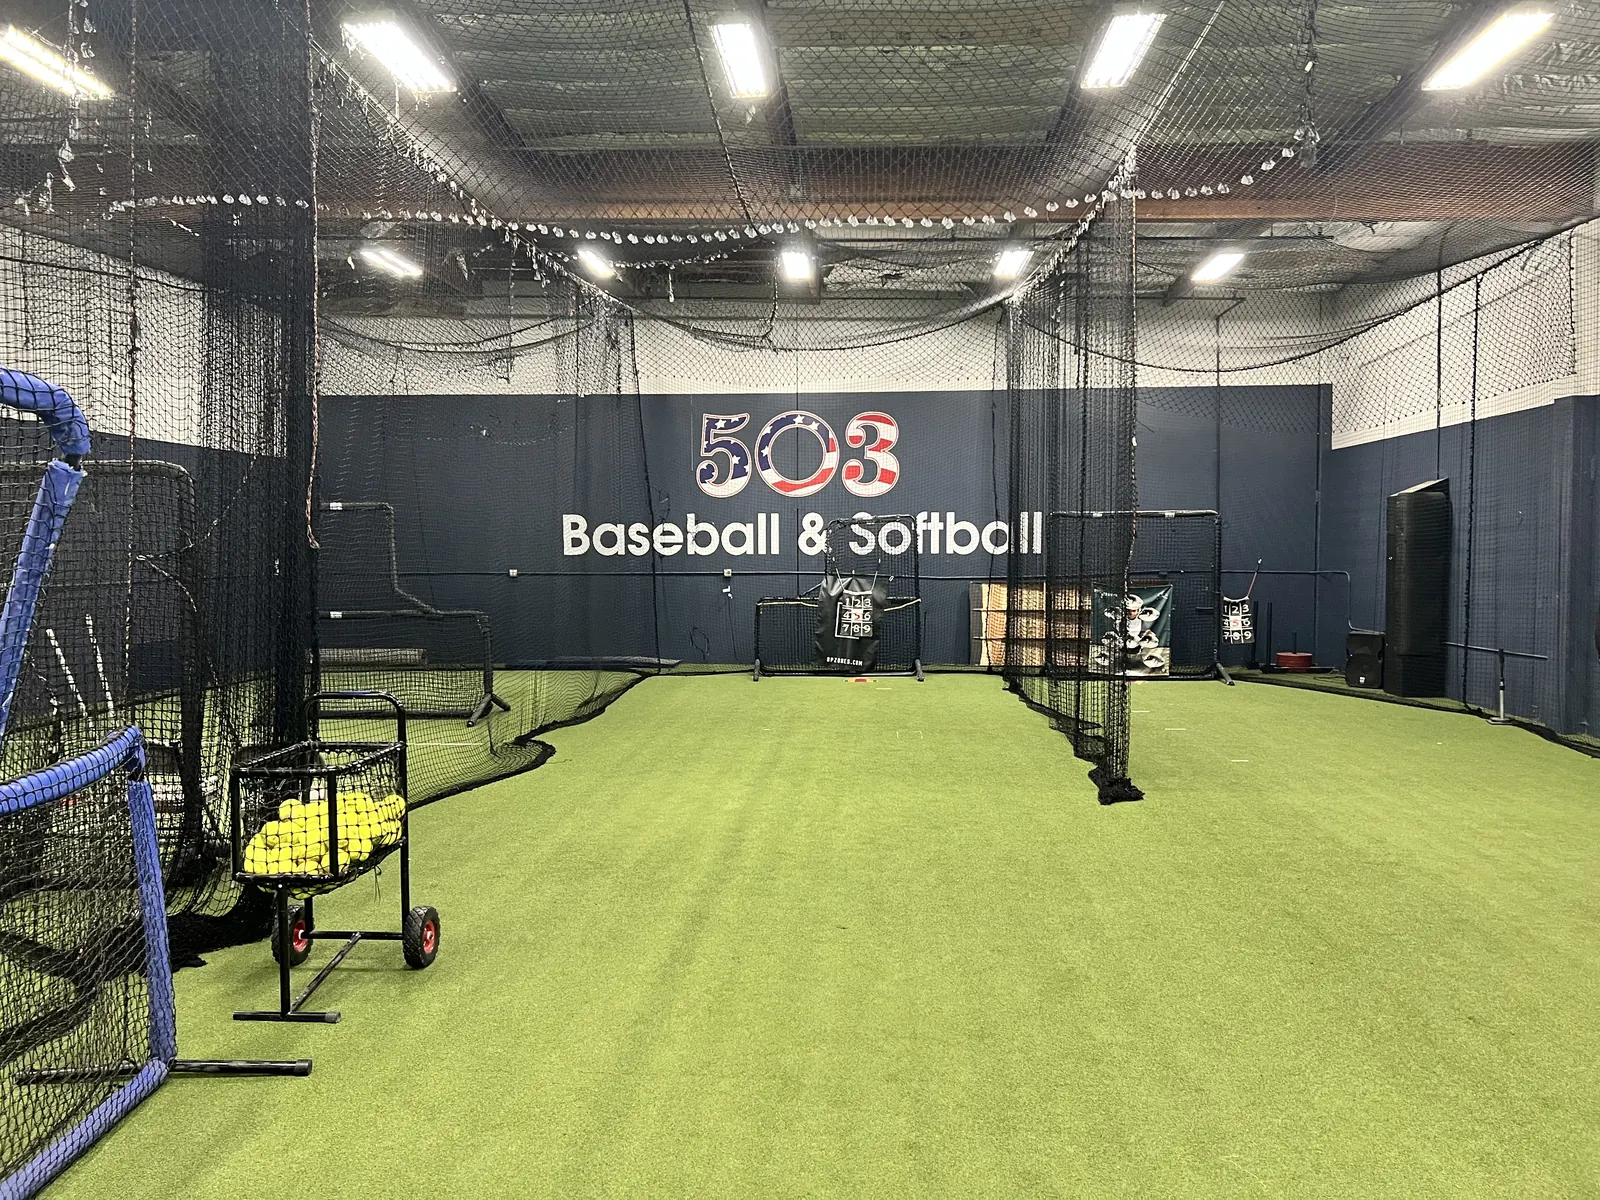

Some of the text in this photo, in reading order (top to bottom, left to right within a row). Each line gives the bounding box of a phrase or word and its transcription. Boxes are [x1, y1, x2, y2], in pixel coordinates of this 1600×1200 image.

[696, 410, 900, 498] 503
[562, 511, 1043, 556] Baseball & Softball
